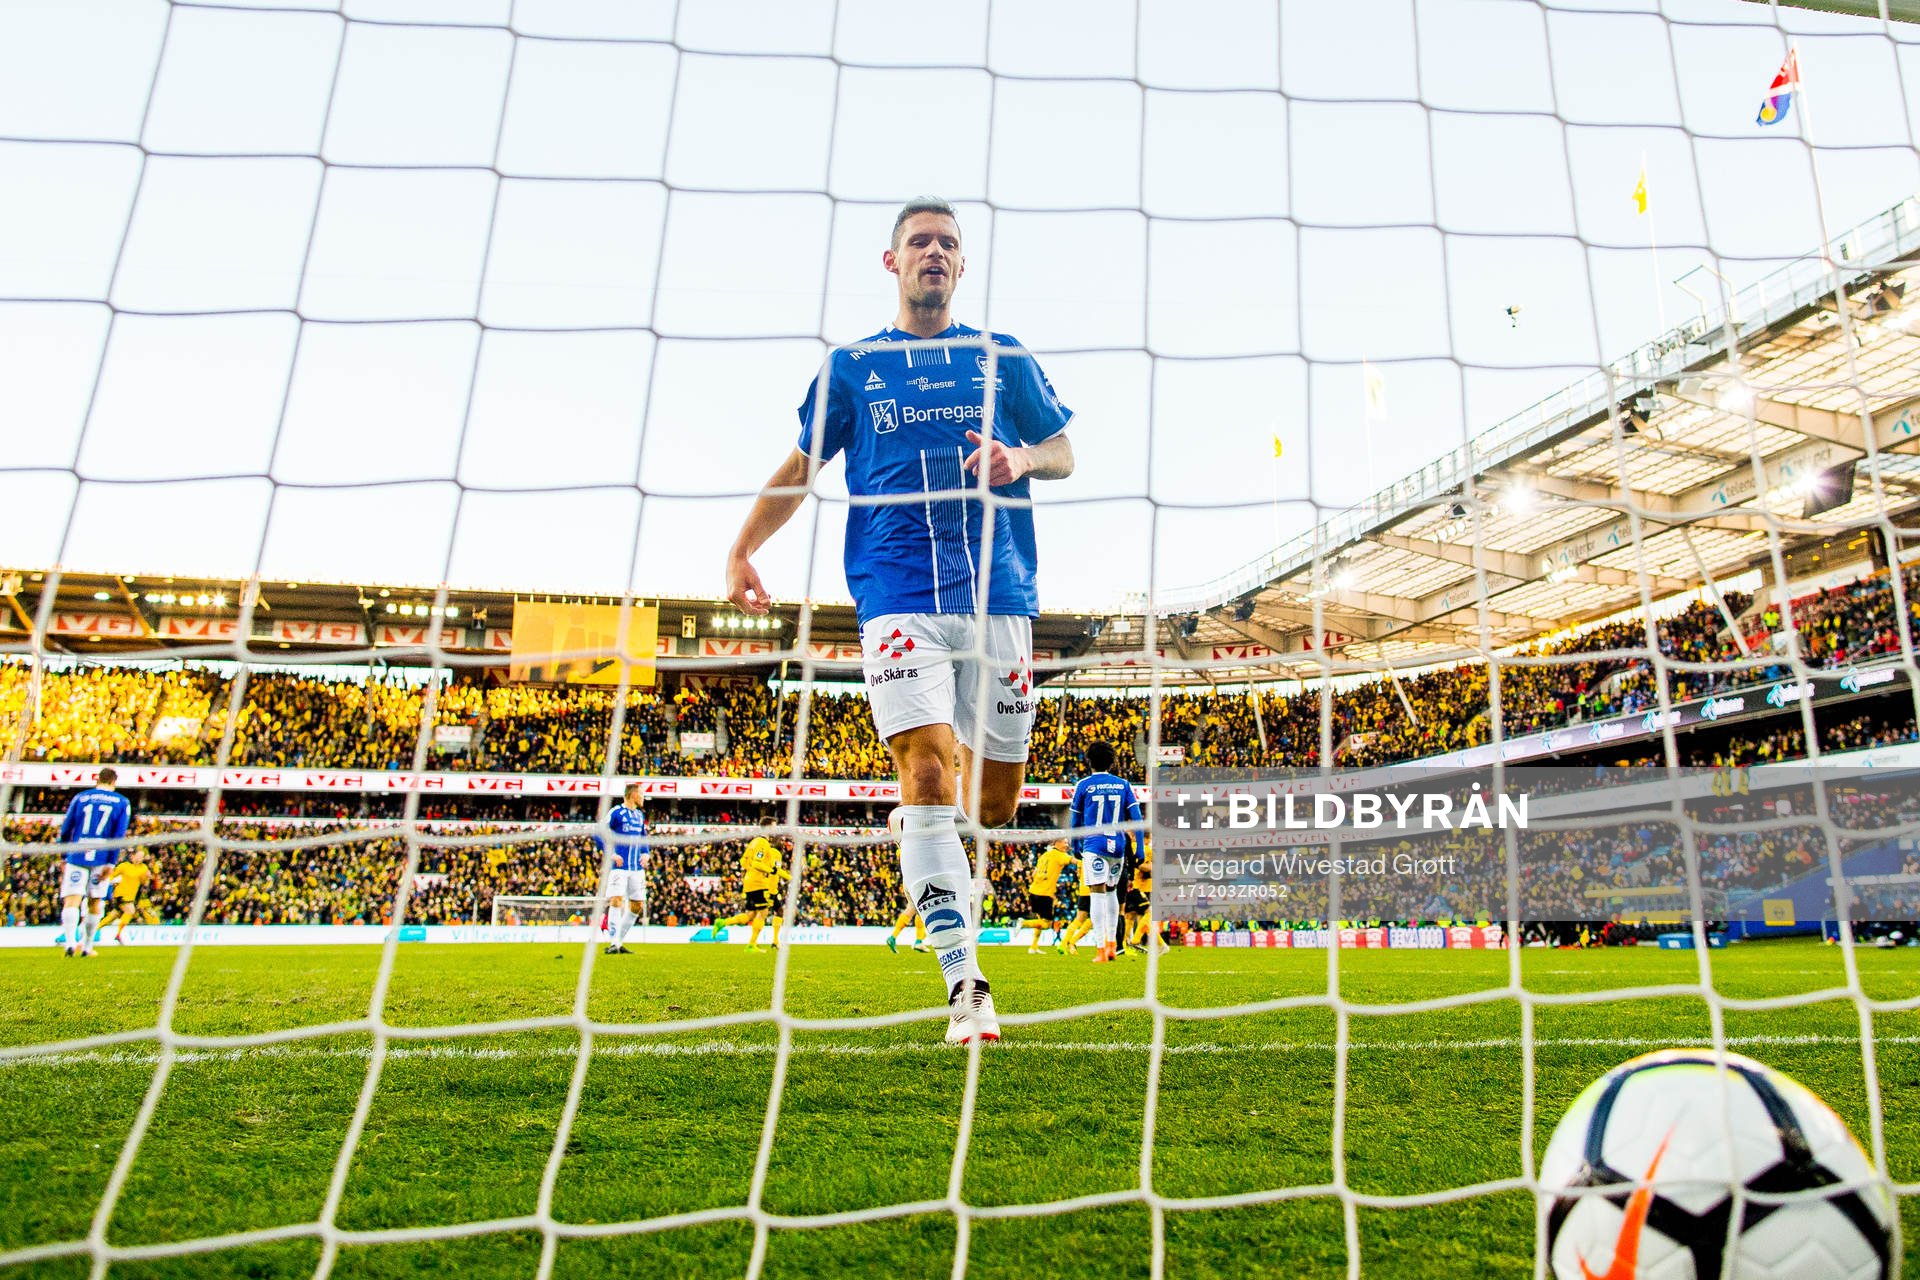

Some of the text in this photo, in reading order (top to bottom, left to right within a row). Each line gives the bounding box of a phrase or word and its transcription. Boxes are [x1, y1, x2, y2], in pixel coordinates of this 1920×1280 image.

[902, 402, 996, 424] Borregaa
[57, 614, 136, 634] VG
[168, 617, 241, 636] VG
[281, 622, 357, 642] VG
[705, 639, 773, 656] VG
[1212, 645, 1271, 661] VG
[871, 667, 919, 687] Ove Skår as
[997, 701, 1014, 715] Ove
[138, 771, 196, 784] VG
[224, 773, 280, 786] VG
[306, 775, 362, 787] VG
[388, 776, 443, 788] VG
[468, 778, 523, 790] VG
[547, 780, 600, 792] VG
[701, 783, 752, 795] VG
[776, 784, 826, 796] VG
[849, 785, 898, 797] VG
[82, 803, 113, 836] 17
